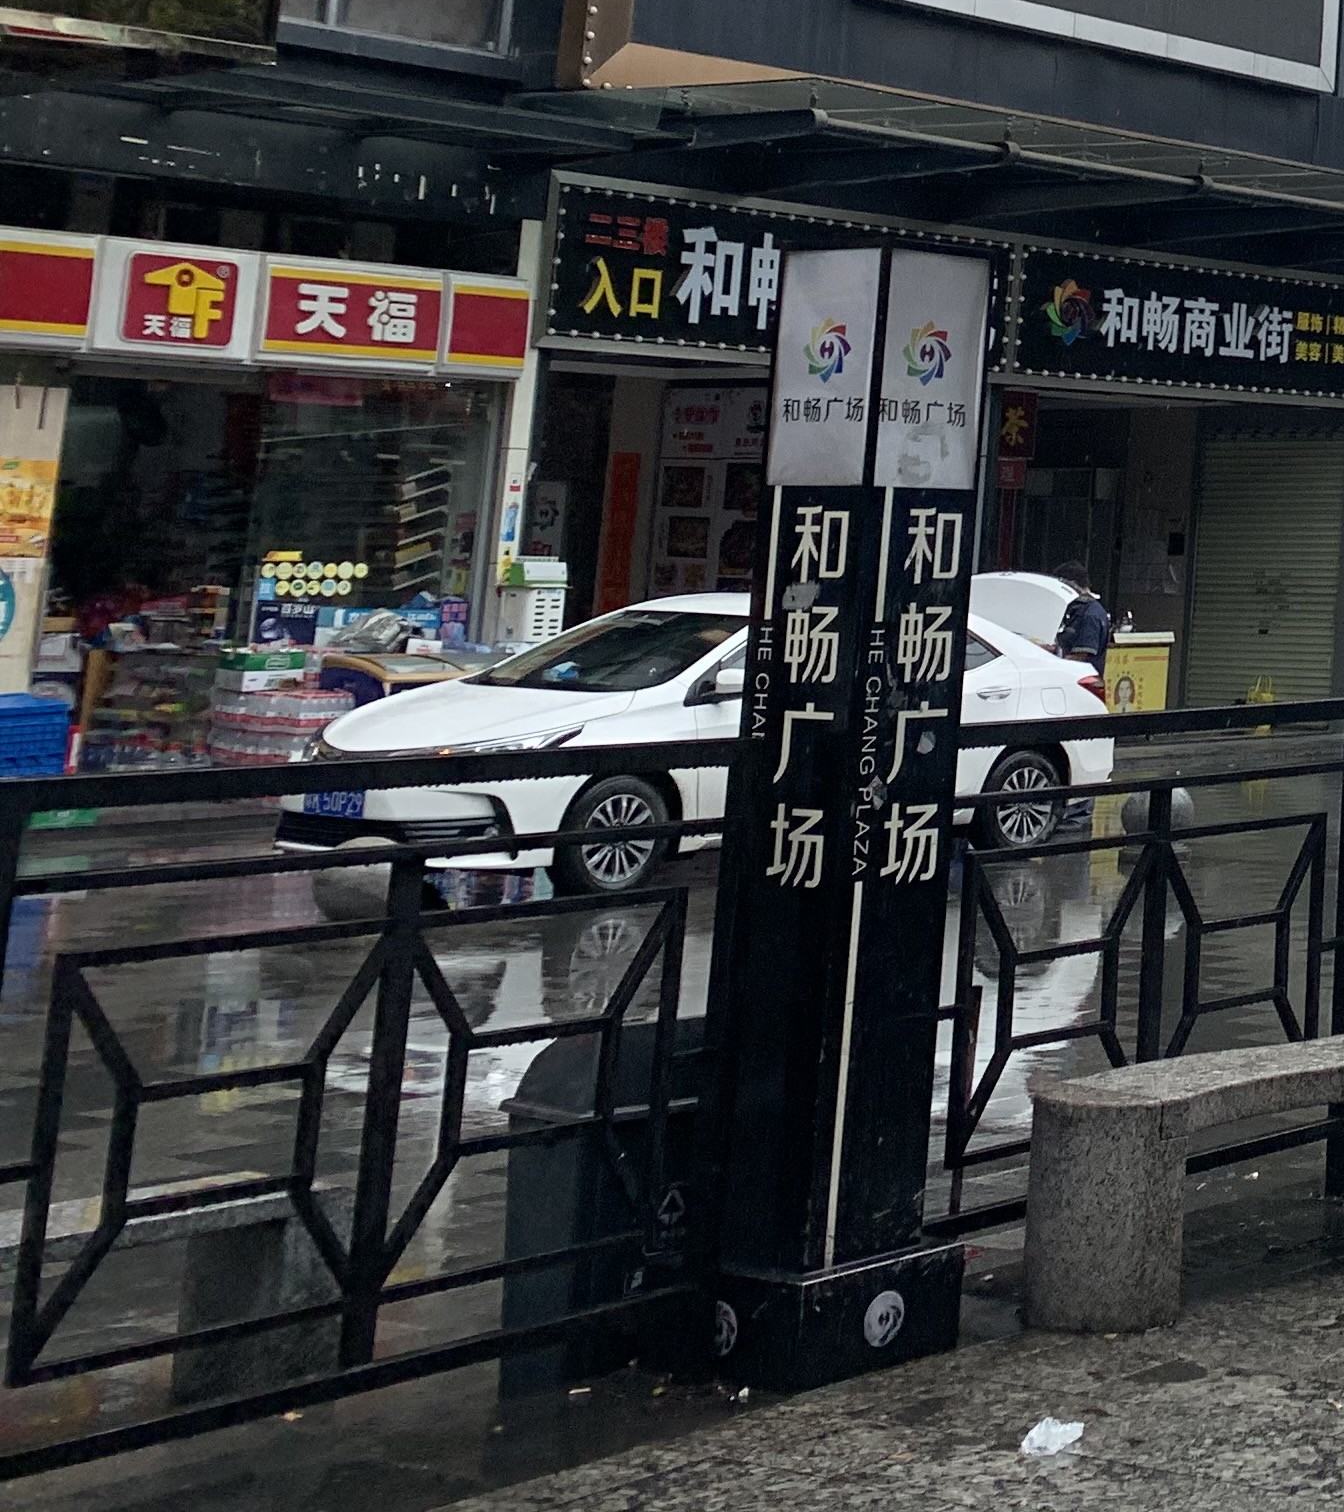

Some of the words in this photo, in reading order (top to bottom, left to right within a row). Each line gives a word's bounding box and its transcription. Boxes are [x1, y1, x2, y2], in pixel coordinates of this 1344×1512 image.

[584, 213, 669, 257] 二三楼
[294, 282, 419, 344] 天福
[580, 256, 664, 320] 入口
[142, 314, 193, 339] 天福
[1100, 287, 1294, 365] 和畅商业街
[782, 396, 864, 424] 和畅广场
[877, 397, 967, 429] 和畅广场
[765, 505, 850, 888] 和畅广场
[859, 676, 883, 776] CHANG
[879, 506, 963, 885] 和畅广场
[851, 787, 875, 876] PLAZA
